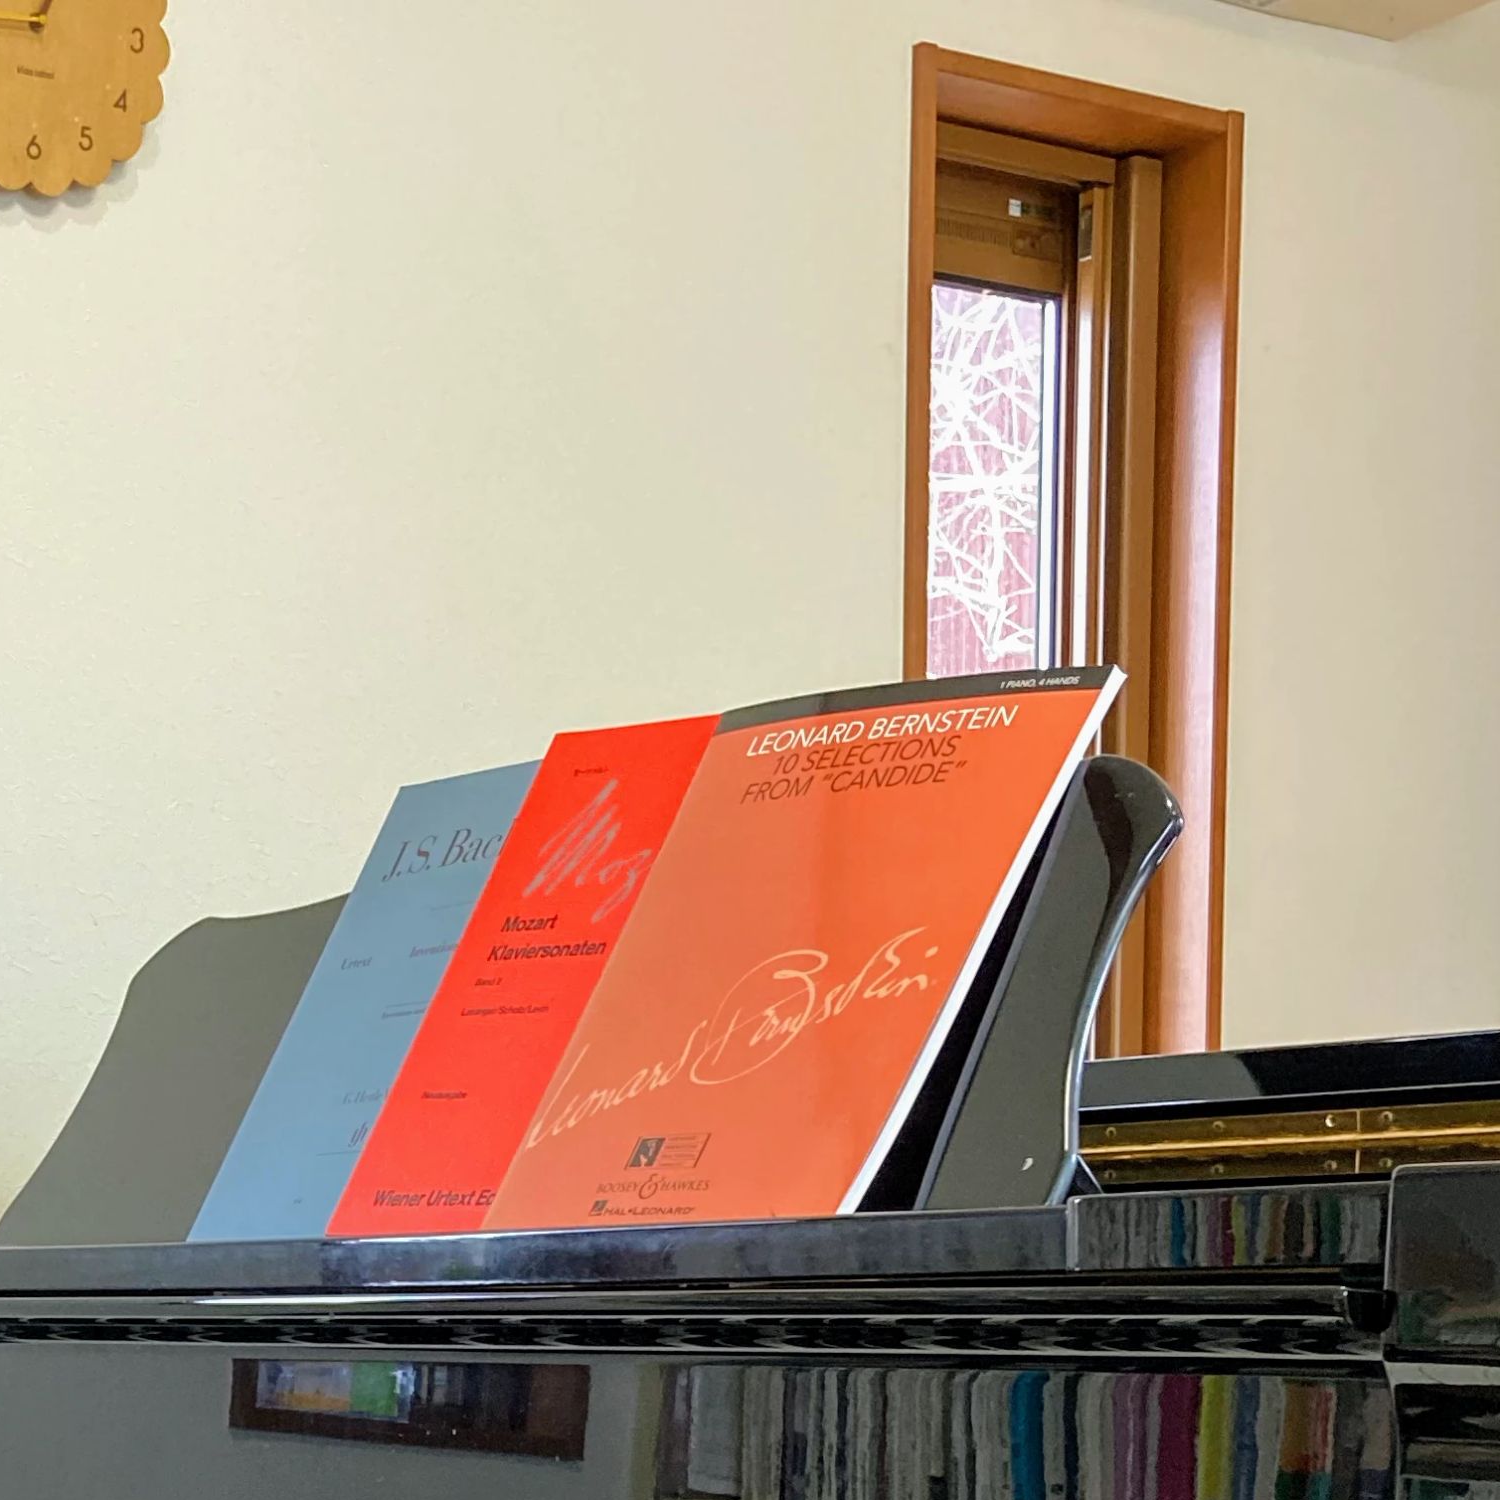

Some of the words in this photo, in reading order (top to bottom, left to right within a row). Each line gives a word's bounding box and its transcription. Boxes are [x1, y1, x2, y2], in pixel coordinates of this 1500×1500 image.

[129, 28, 145, 53] 3
[113, 89, 127, 113] 4
[26, 135, 42, 160] 6
[78, 126, 94, 152] 5
[1038, 678, 1045, 686] 4
[1045, 676, 1081, 686] HANDS
[746, 720, 865, 758] LEONARD
[867, 704, 1019, 741] BERNSTEIN
[772, 757, 800, 777] 10
[801, 734, 962, 773] SELECTIONS
[740, 776, 813, 805] FROM
[500, 914, 558, 933] Mozart
[487, 940, 608, 962] Klaviersonaten
[526, 1020, 706, 1150] Leonard
[660, 1179, 712, 1192] HAWKES
[373, 1190, 426, 1207] Wiener
[426, 1191, 475, 1207] Urtext
